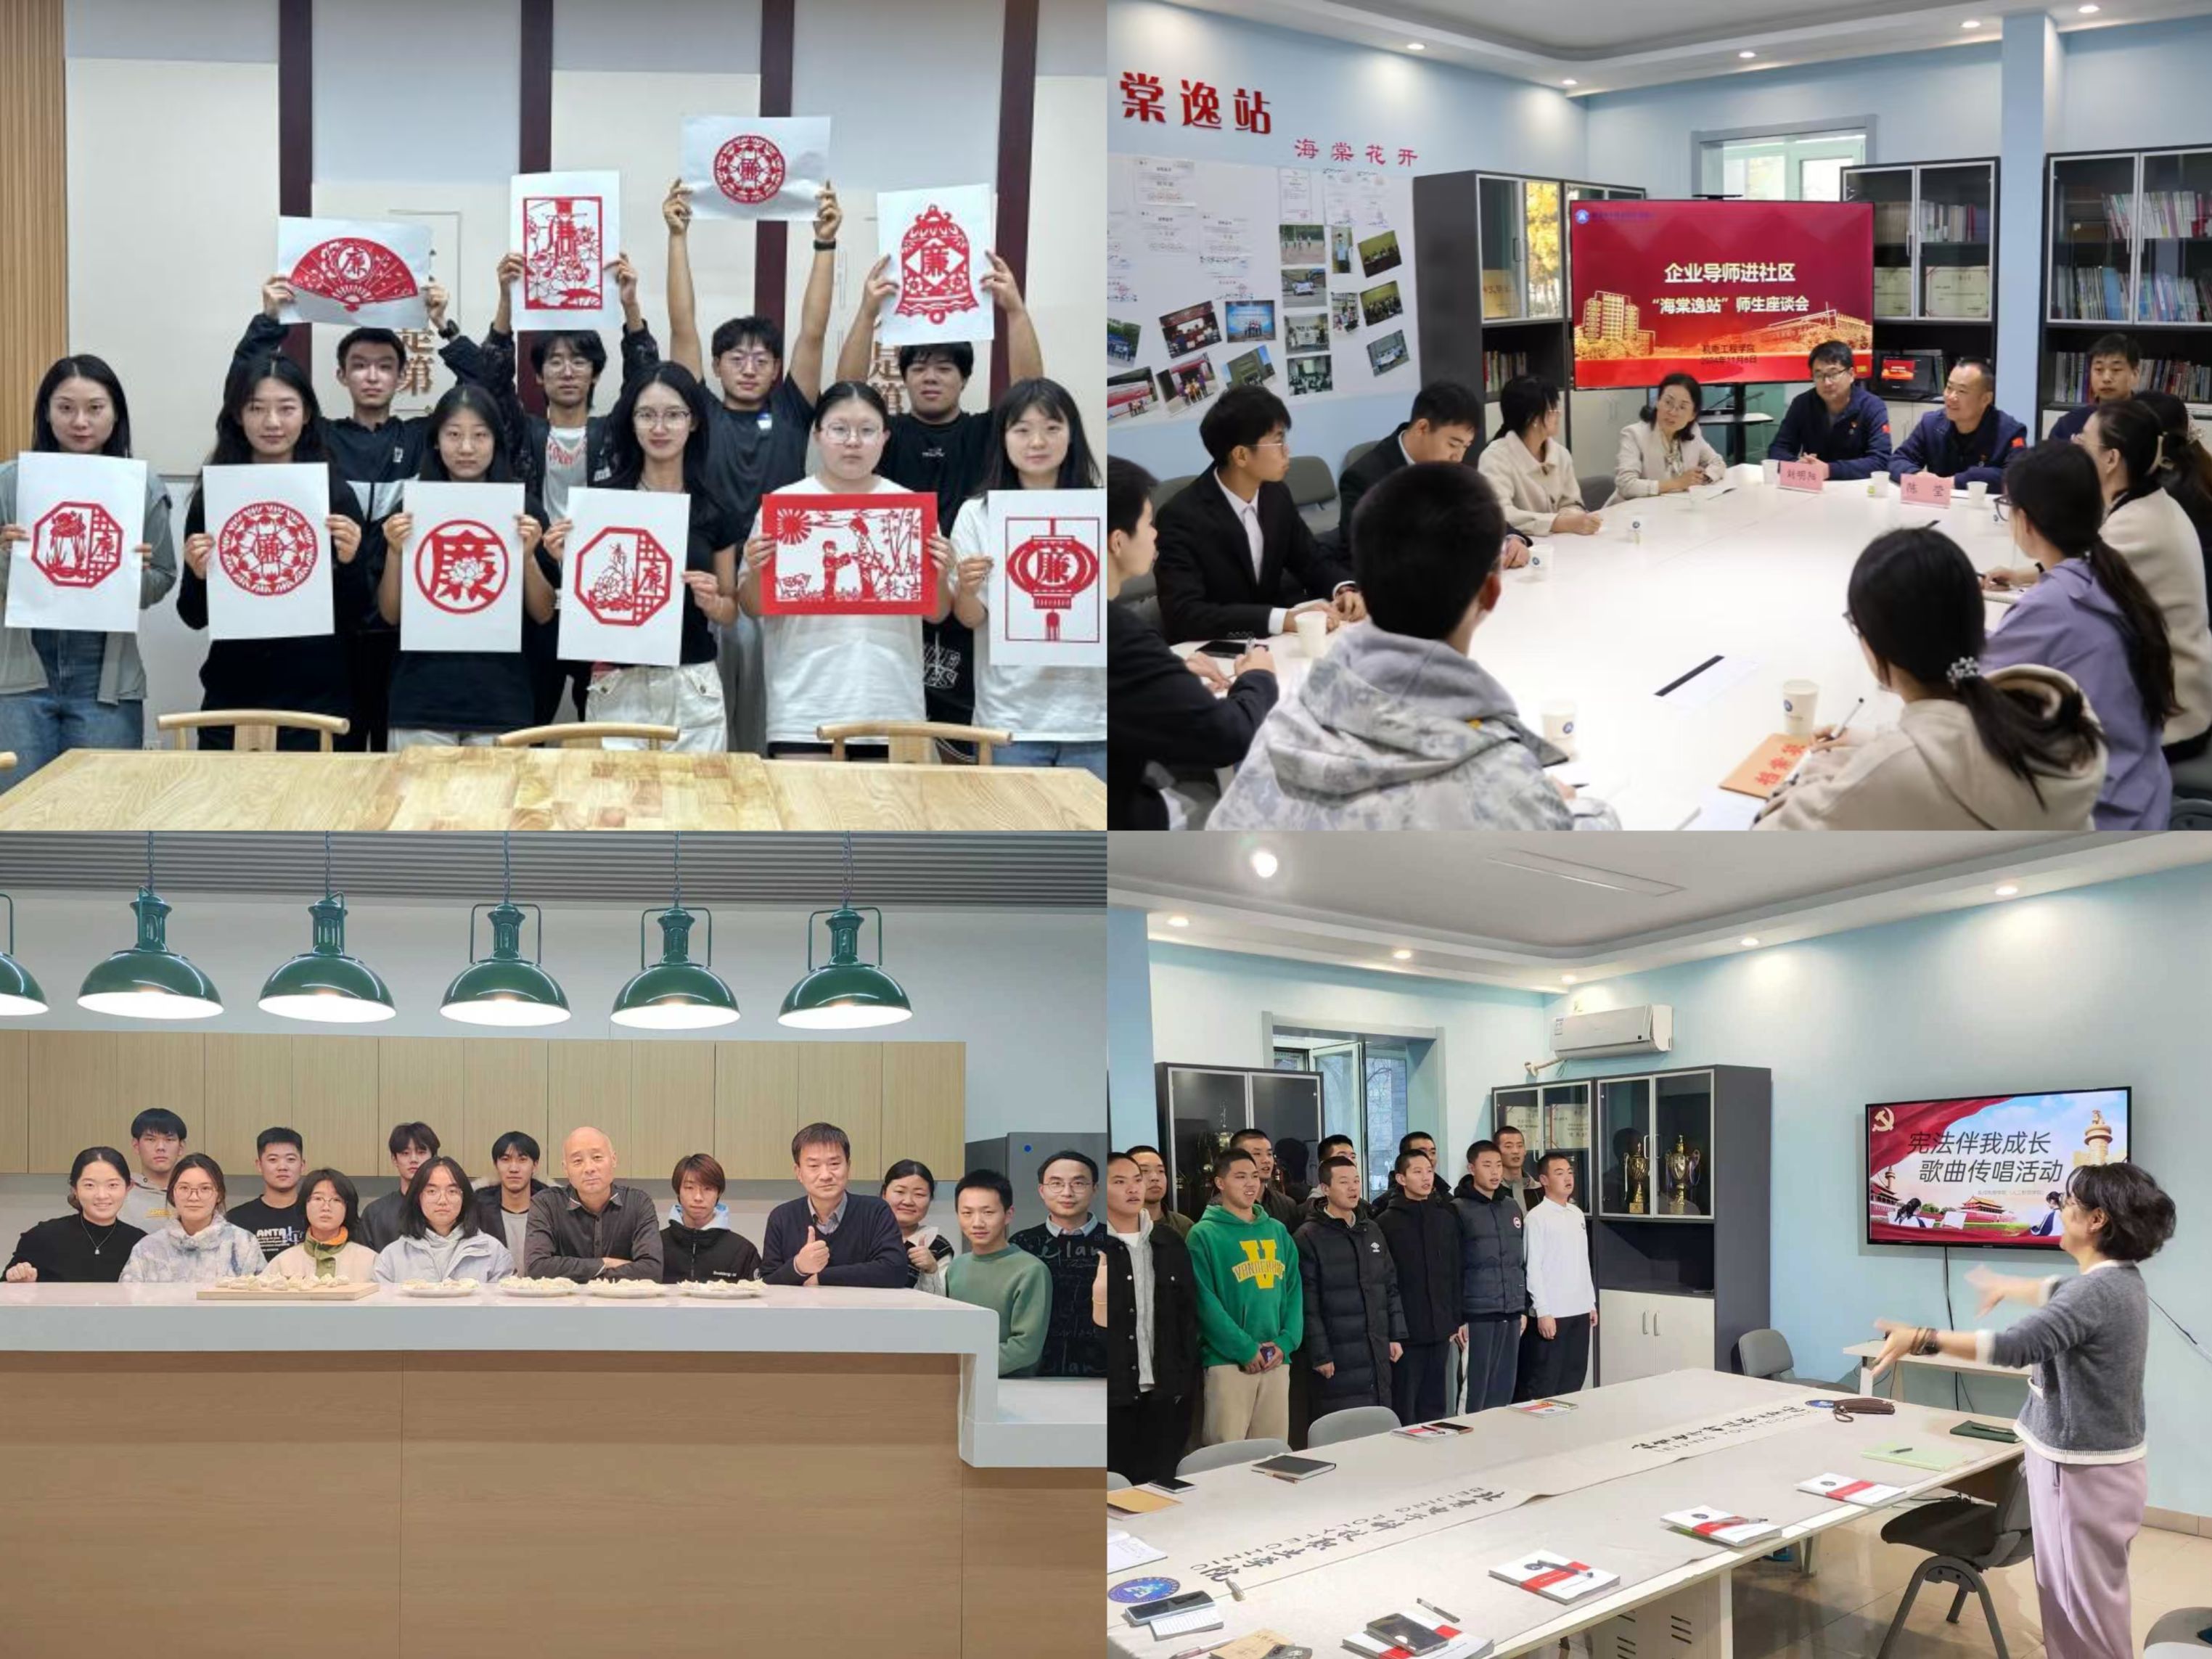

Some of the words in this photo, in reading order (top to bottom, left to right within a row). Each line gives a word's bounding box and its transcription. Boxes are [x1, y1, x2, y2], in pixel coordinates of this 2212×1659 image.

[1120, 72, 1271, 135] 棠逸站
[1295, 138, 1419, 168] 海棠花开
[1664, 262, 1795, 284] 企业导师进社区
[1907, 1131, 2051, 1155] 宪法伴我成长
[1918, 1159, 2063, 1184] 歌曲传唱活动
[1394, 1486, 1484, 1513] BEIJING
[1189, 1514, 1385, 1572] POLYTECHNIC
